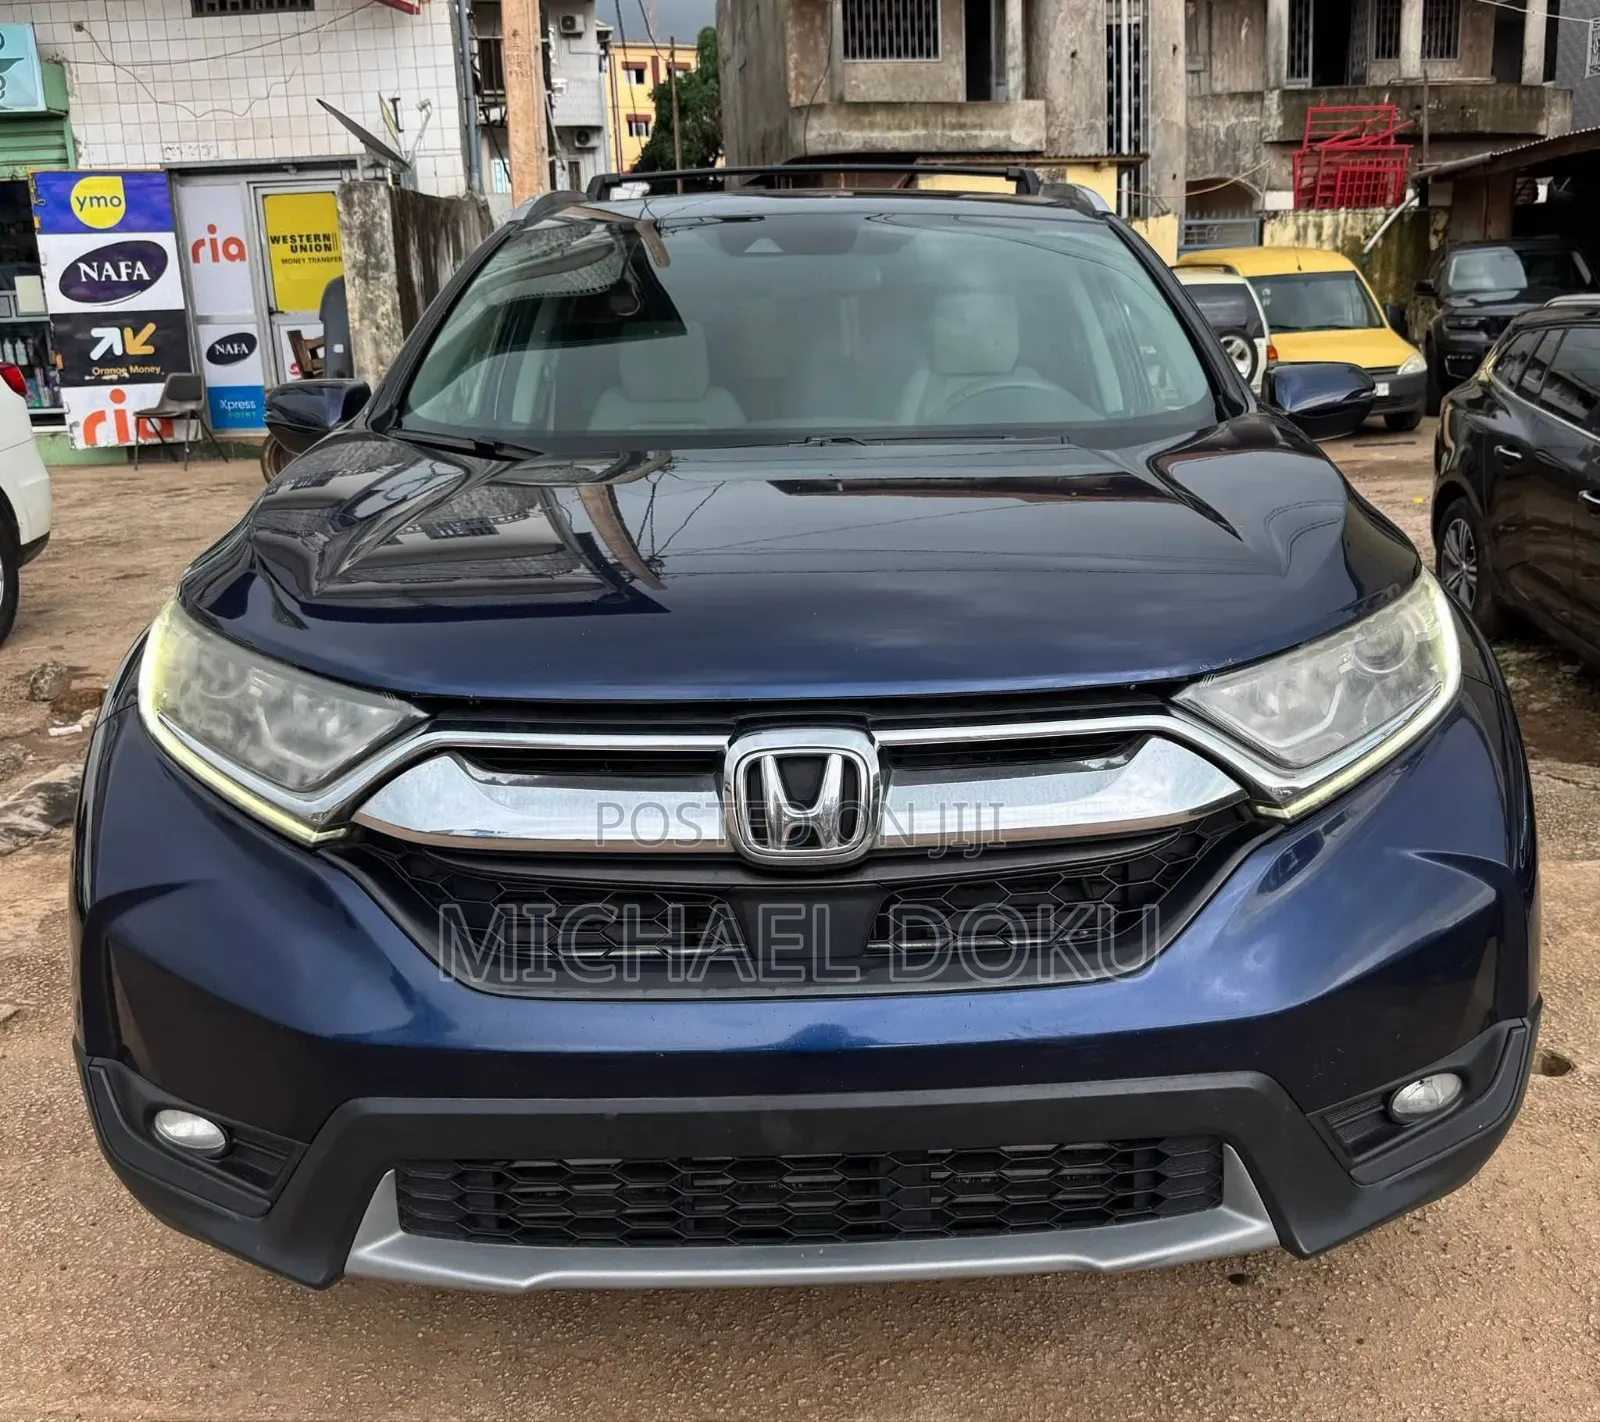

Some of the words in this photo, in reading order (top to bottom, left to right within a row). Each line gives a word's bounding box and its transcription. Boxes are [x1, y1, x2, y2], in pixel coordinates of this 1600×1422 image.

[76, 195, 122, 211] ymo
[191, 224, 247, 264] ria
[270, 233, 332, 245] WESTERN
[290, 244, 333, 253] UNION
[281, 256, 306, 264] MONEY
[77, 261, 151, 282] NAFA
[215, 342, 249, 355] NAFA
[92, 366, 128, 377] Orange
[129, 365, 161, 375] Money
[220, 399, 257, 411] Xpress
